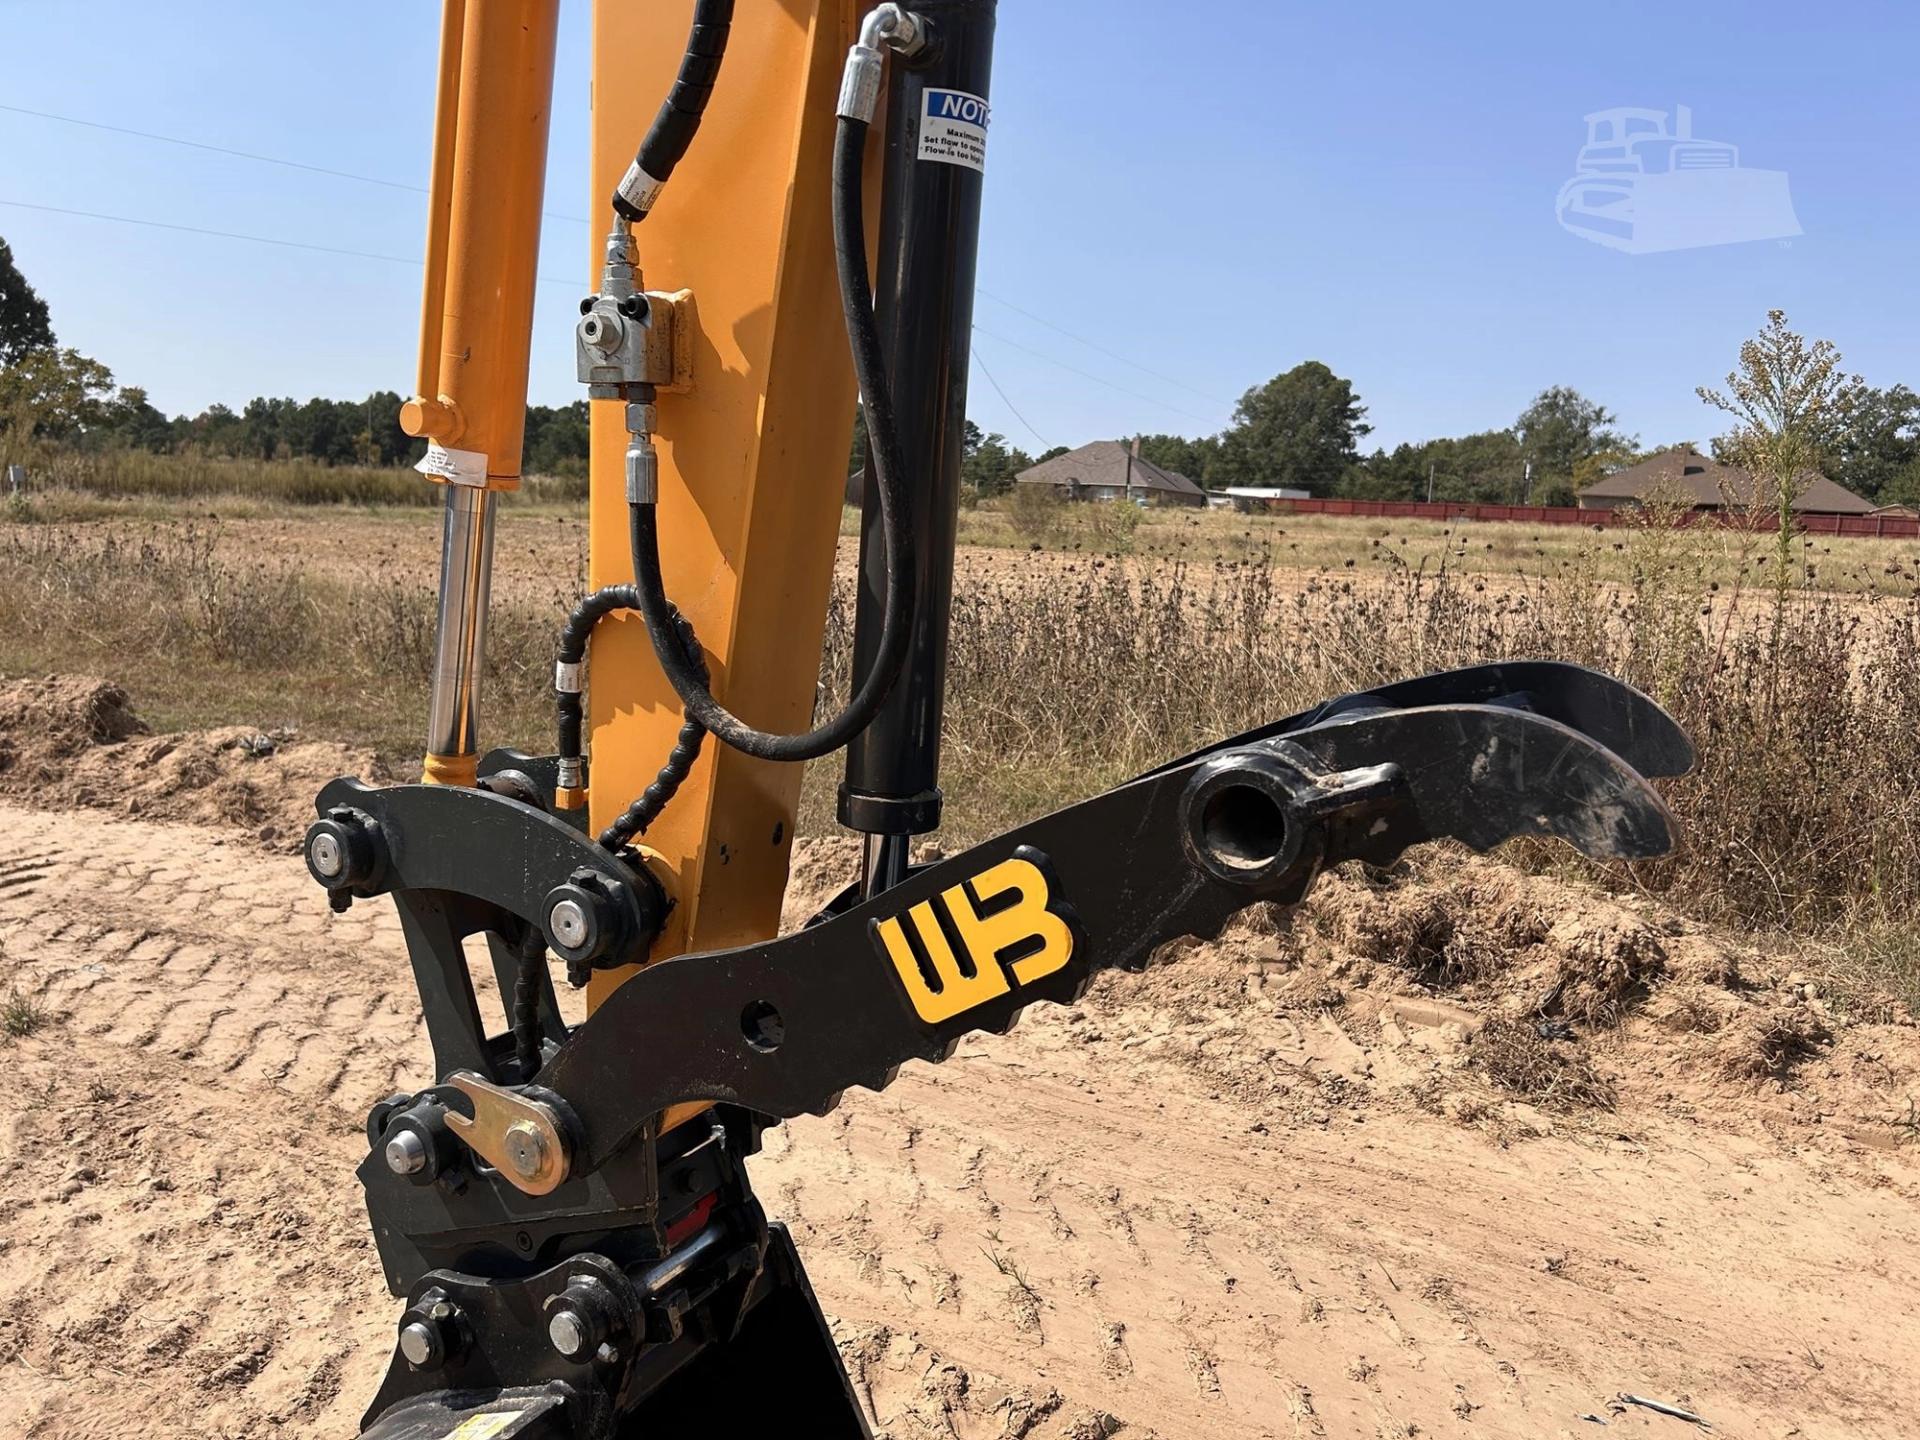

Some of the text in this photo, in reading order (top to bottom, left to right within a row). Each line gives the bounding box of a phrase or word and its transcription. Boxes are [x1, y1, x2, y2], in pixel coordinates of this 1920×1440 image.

[924, 135, 938, 144] Set
[941, 137, 959, 147] flow
[960, 141, 968, 149] to
[925, 145, 945, 154] Flow
[957, 150, 969, 160] too
